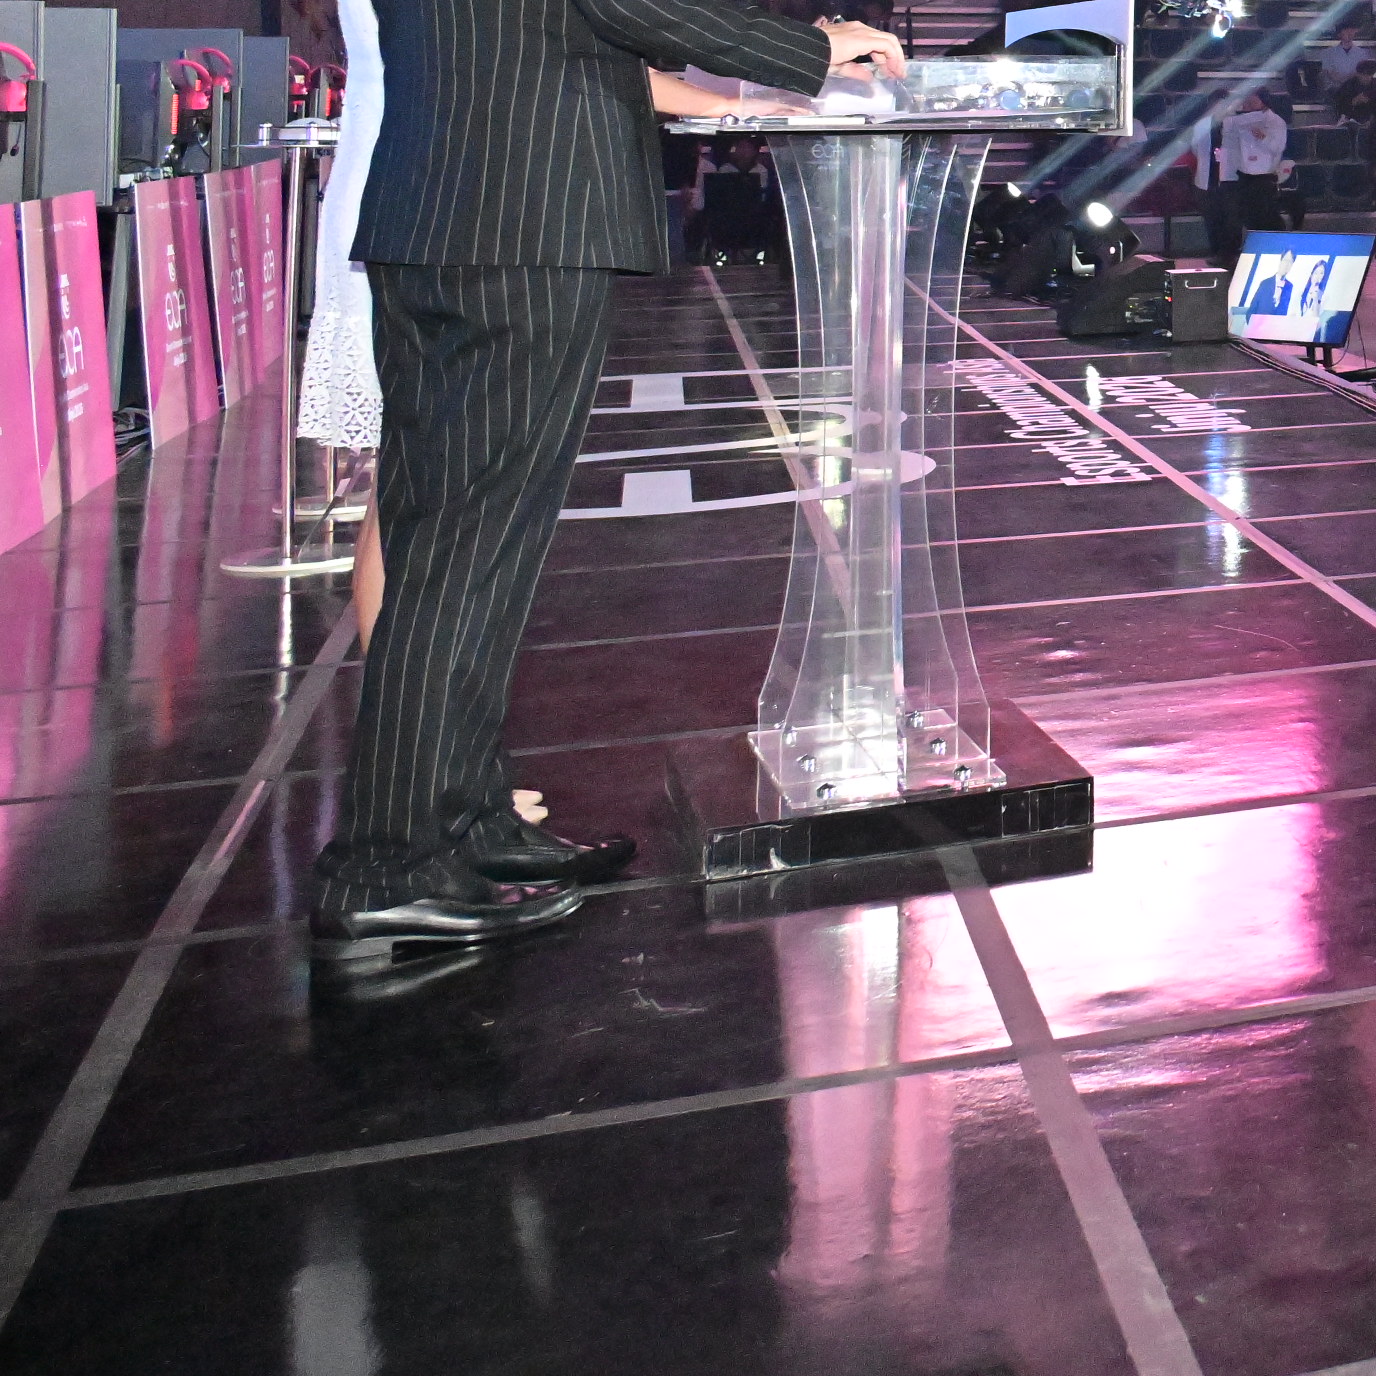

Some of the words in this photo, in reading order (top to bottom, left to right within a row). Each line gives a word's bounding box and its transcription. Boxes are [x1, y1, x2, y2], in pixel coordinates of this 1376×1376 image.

[961, 373, 1090, 439] Championships
[1098, 375, 1200, 403] 2026
[1135, 402, 1252, 432] Jinju
[1032, 438, 1152, 486] Esports
